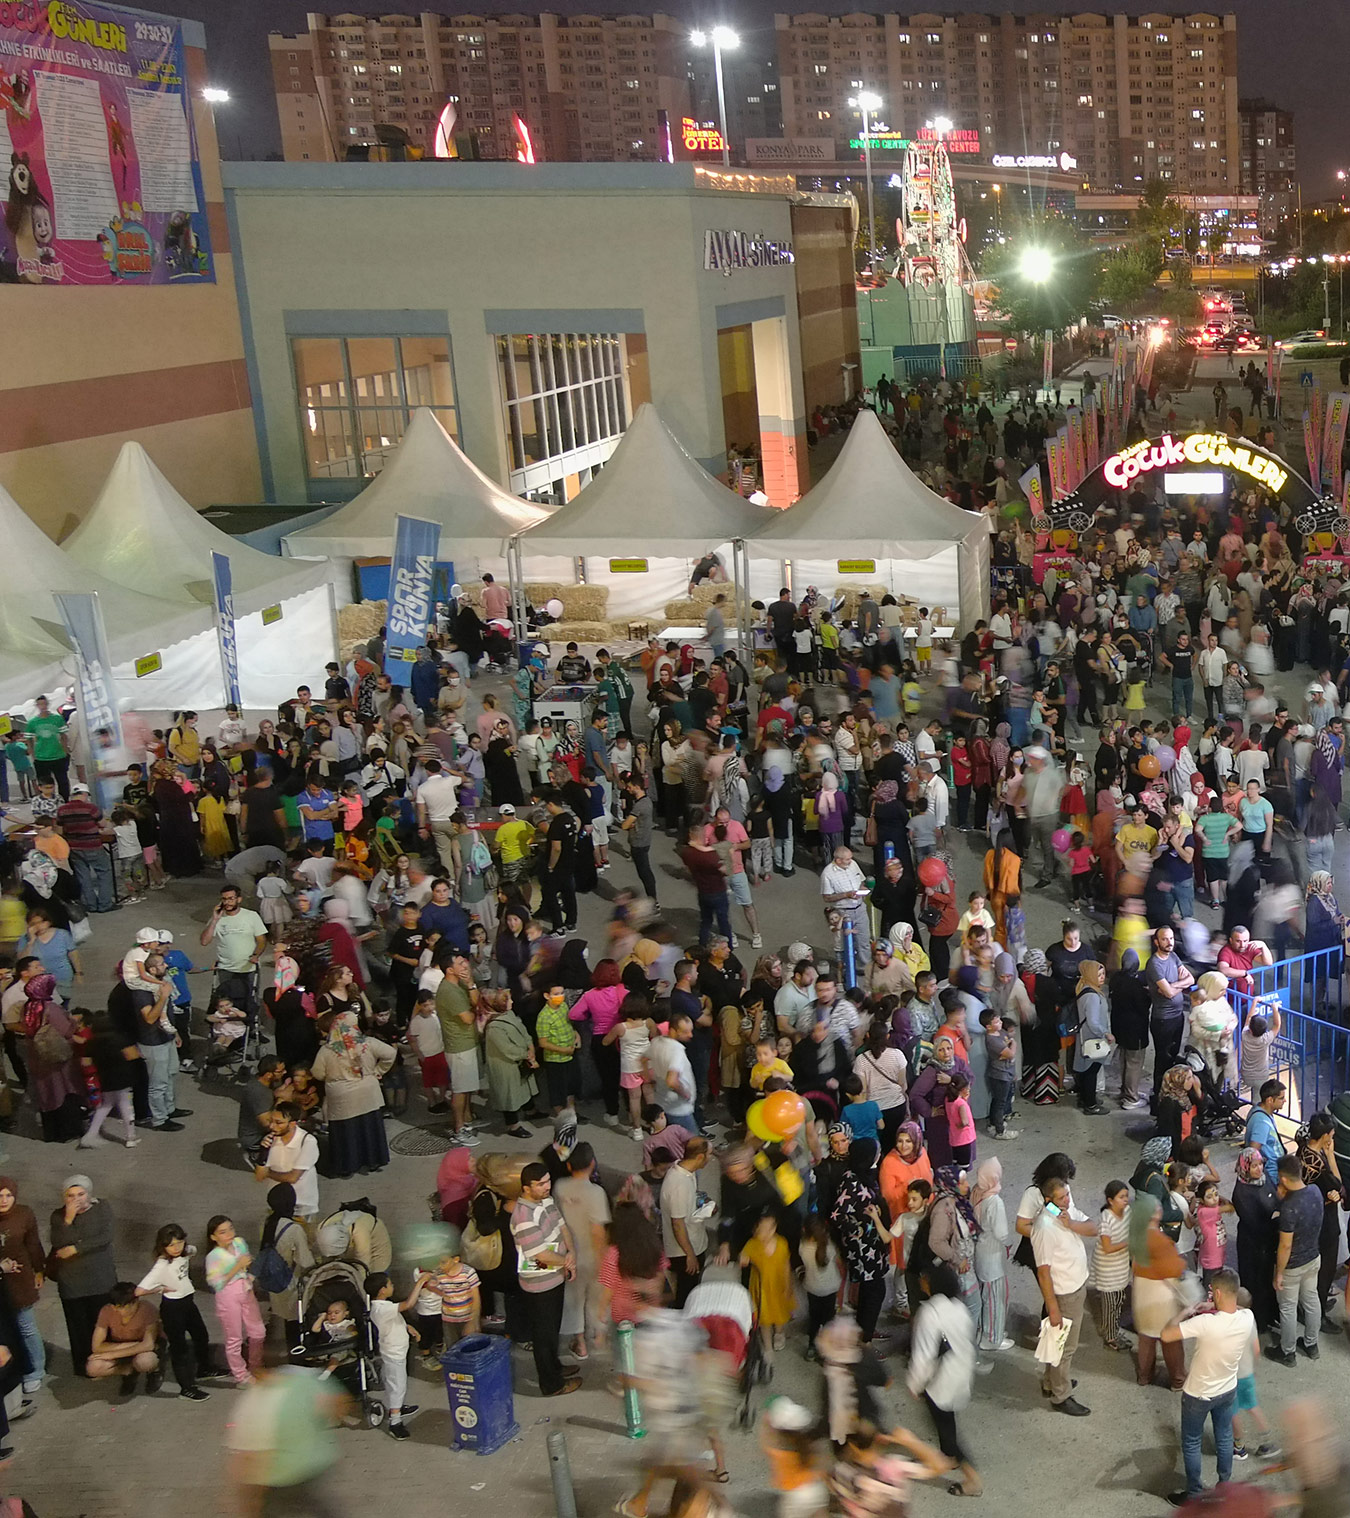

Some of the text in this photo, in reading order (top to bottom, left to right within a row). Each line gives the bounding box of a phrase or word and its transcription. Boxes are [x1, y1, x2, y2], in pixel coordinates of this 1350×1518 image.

[48, 1, 128, 53] GÜNLERİ
[685, 137, 730, 150] OTEL
[756, 145, 824, 154] KONYA PARK
[850, 139, 880, 149] SPOTS
[949, 141, 980, 152] CENTER
[1184, 433, 1288, 493] GÜNLERİ
[390, 567, 415, 637] SPOR
[407, 555, 435, 639] KONYA
[1274, 1037, 1296, 1051] KONYA
[1269, 1045, 1300, 1066] POLİS
